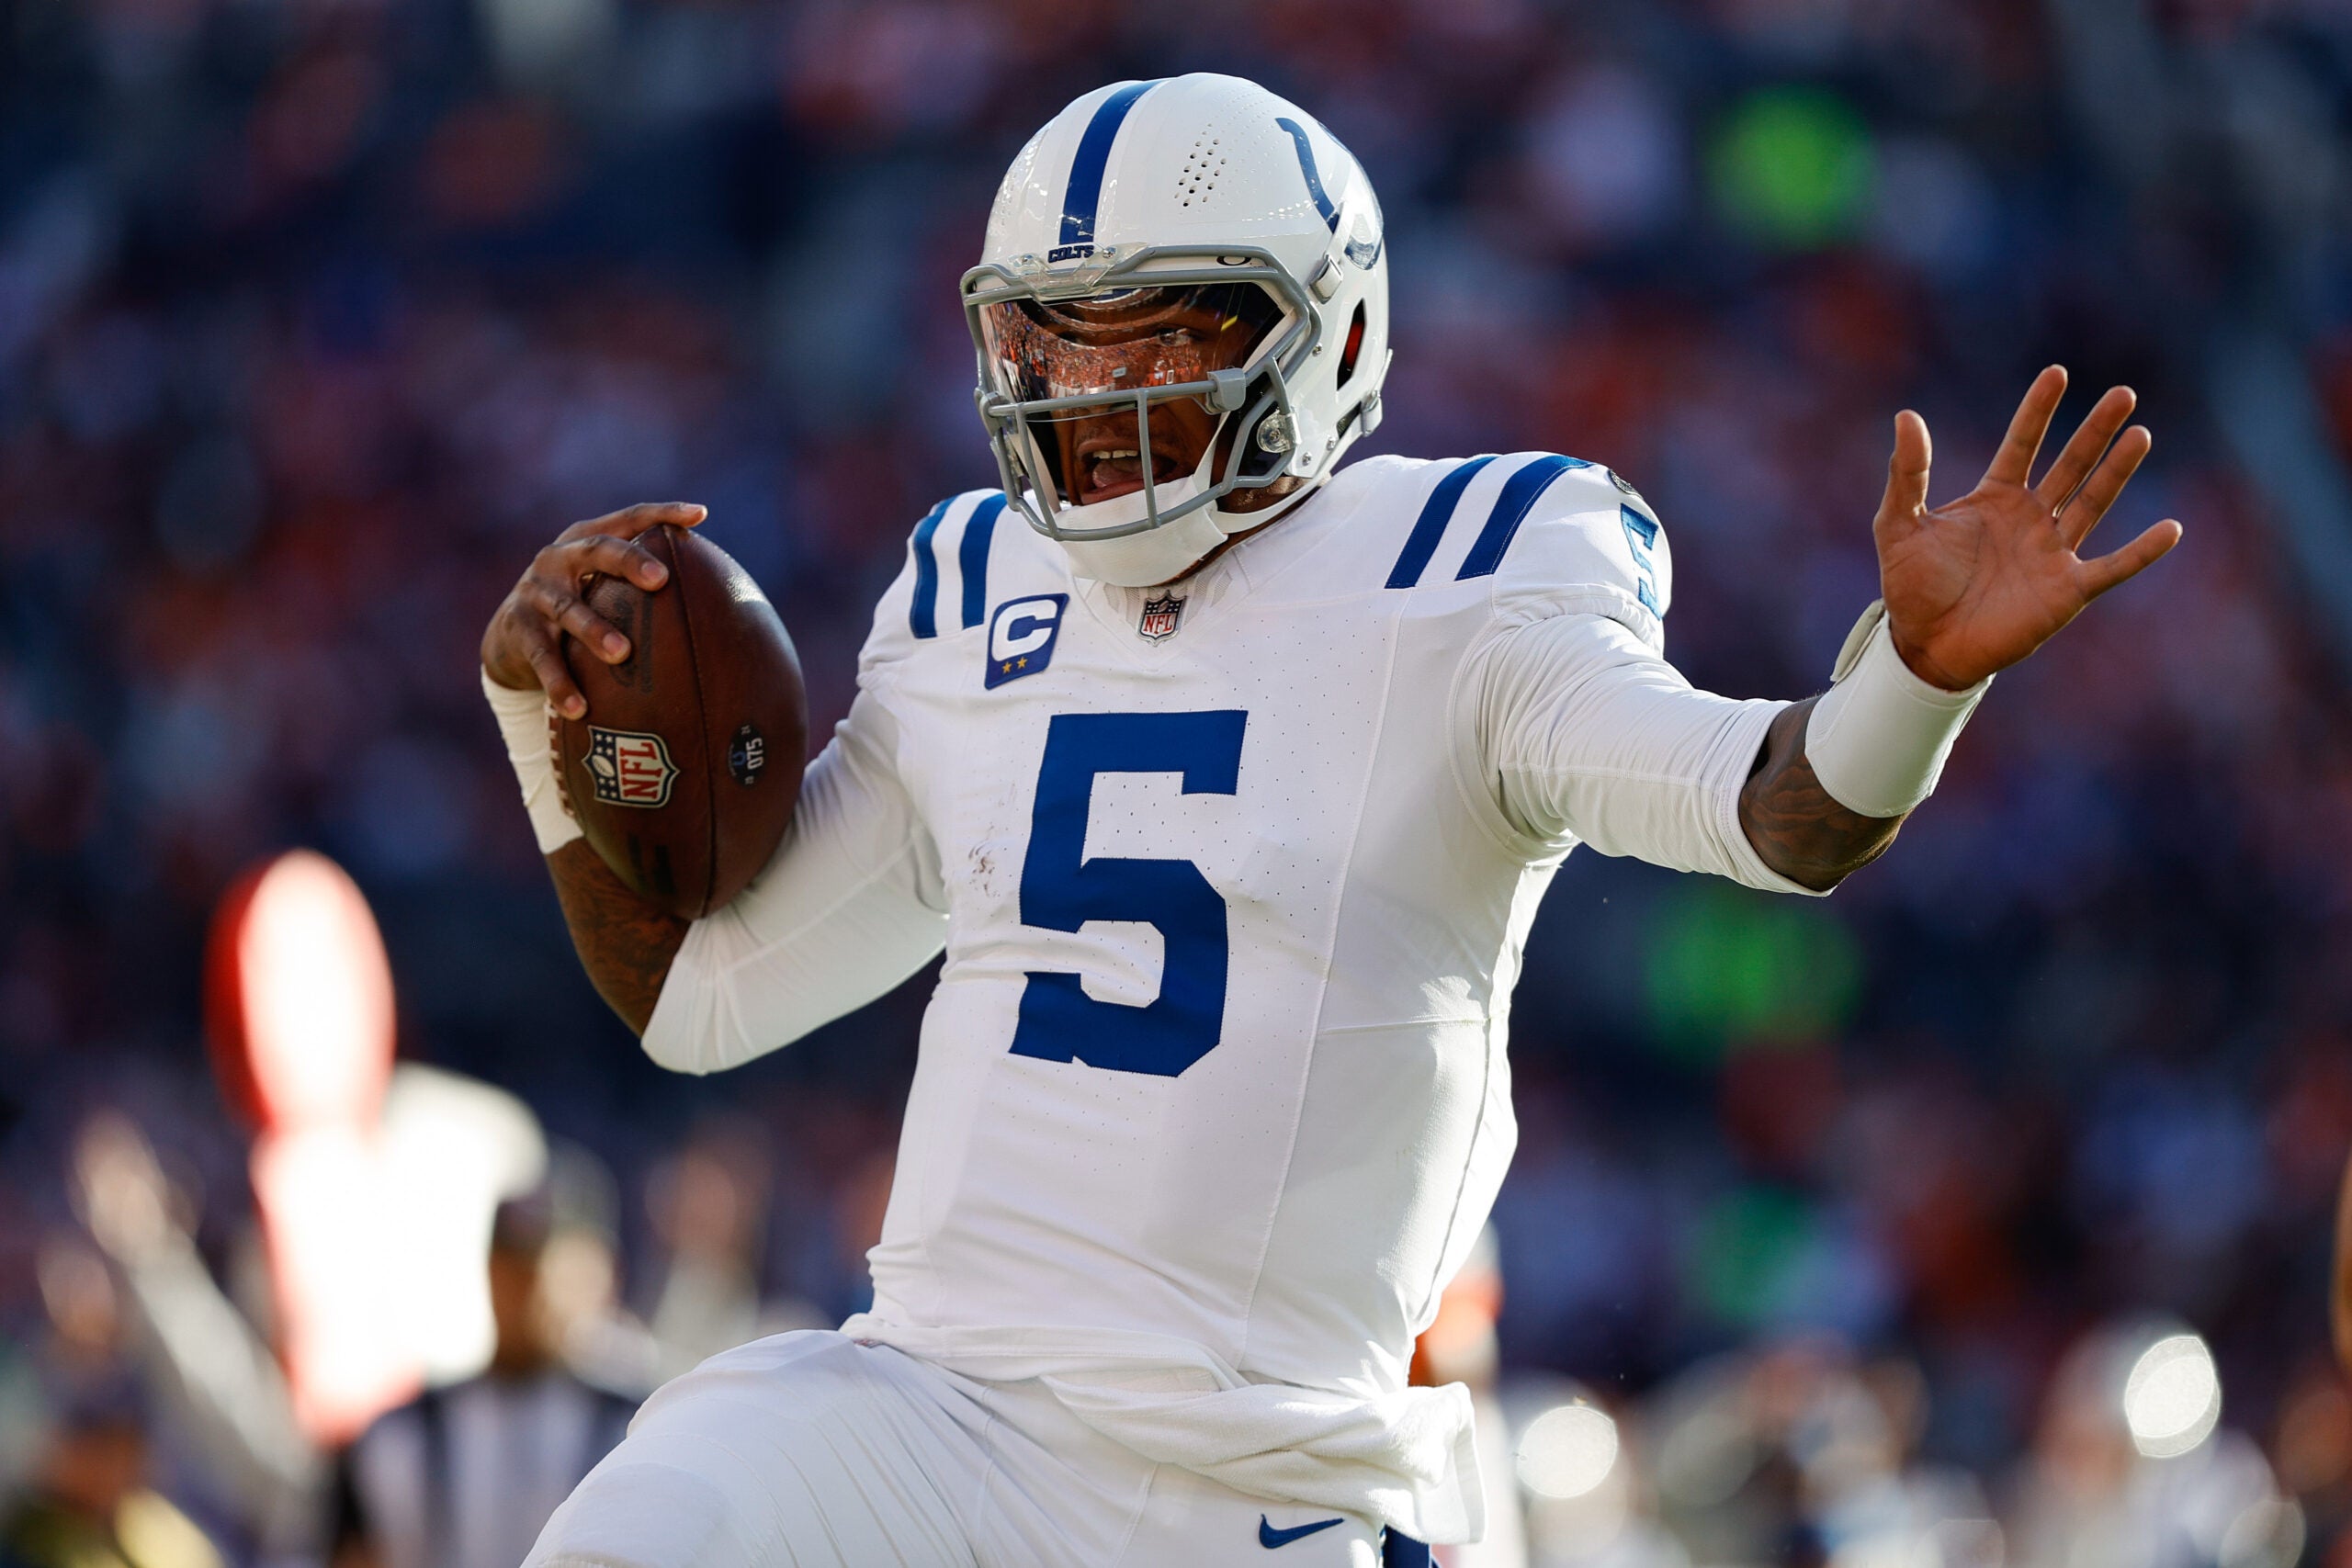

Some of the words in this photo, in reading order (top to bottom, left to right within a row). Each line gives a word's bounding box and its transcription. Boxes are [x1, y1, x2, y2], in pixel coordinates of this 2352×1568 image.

[1048, 245, 1094, 263] COLTS
[1620, 502, 1662, 621] 5
[991, 599, 1057, 661] C
[1143, 614, 1174, 635] NFL
[619, 741, 663, 800] NFL
[745, 738, 764, 770] 075
[1008, 710, 1249, 1077] 5
